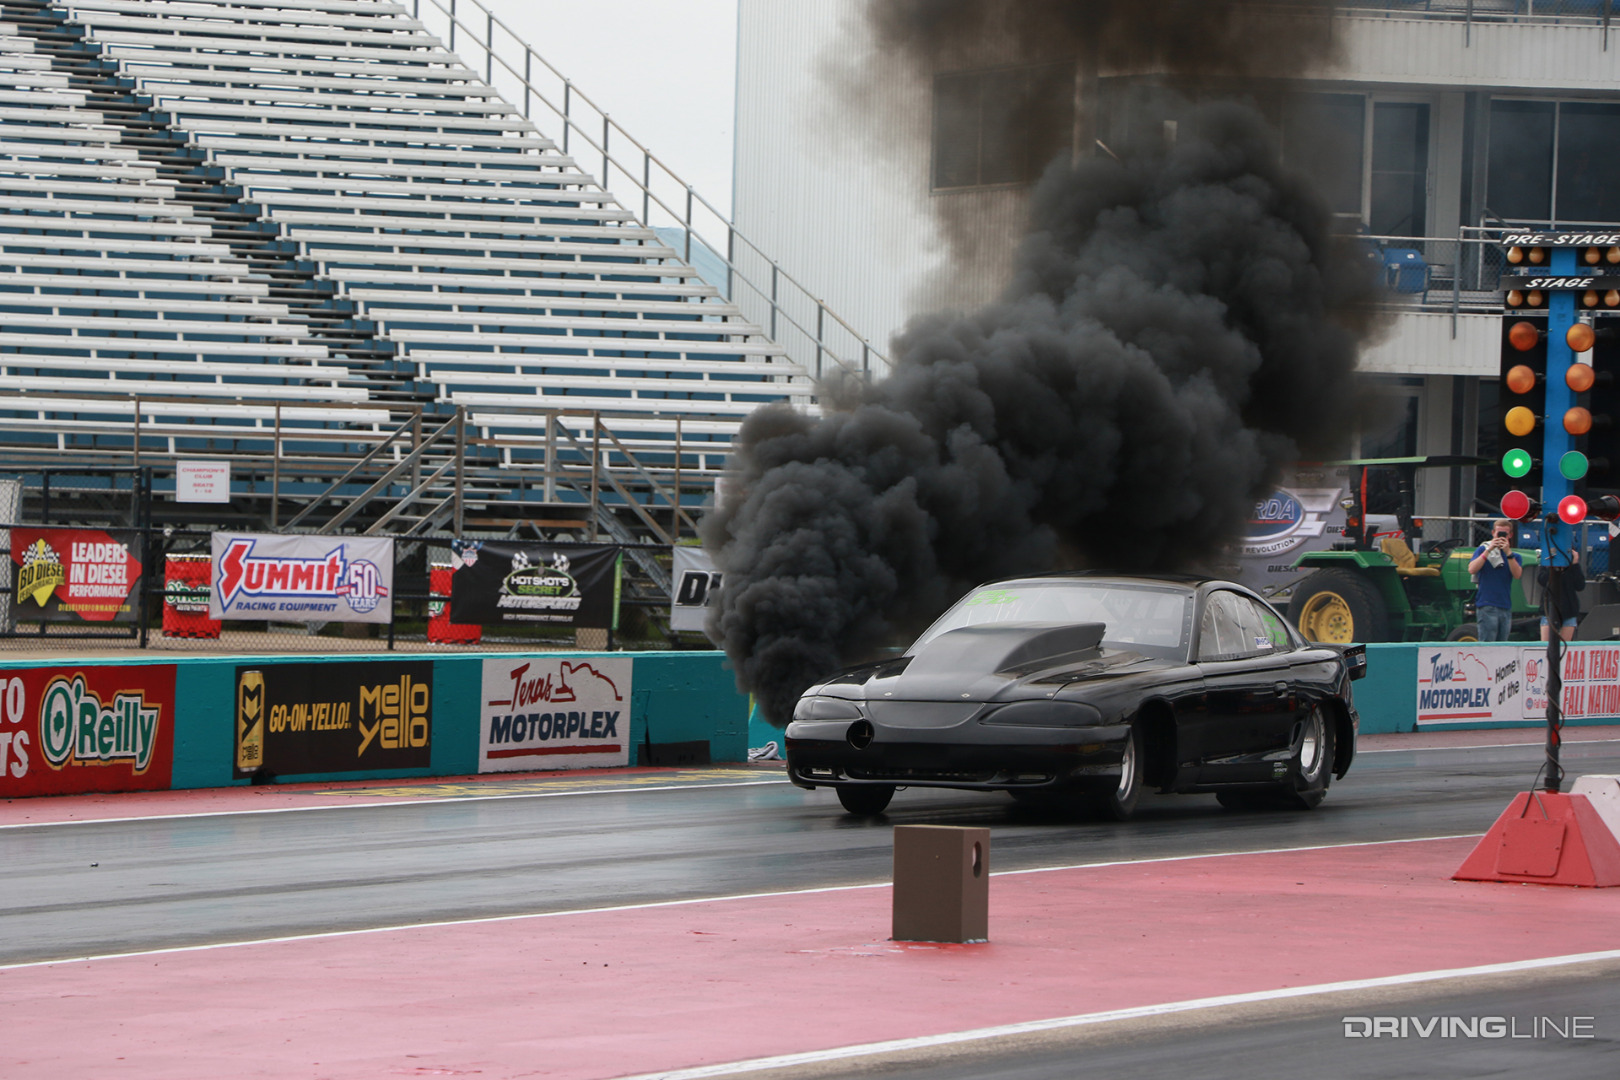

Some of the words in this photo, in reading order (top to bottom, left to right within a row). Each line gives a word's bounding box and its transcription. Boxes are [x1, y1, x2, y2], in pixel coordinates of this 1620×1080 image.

[1503, 234, 1620, 245] PRE-STAGE
[1525, 278, 1594, 288] STAGE
[72, 542, 128, 564] LEADERS
[1245, 537, 1296, 554] REVOLUTION
[20, 569, 34, 590] BD
[70, 563, 86, 584] IN
[87, 564, 128, 585] DIESEL
[349, 563, 377, 599] 50
[68, 584, 128, 598] PERFORMANCE.
[517, 585, 563, 595] SECRET
[235, 601, 276, 612] RACING
[279, 602, 338, 612] EQUIPMENT
[349, 598, 377, 608] YEARS
[497, 595, 582, 610] MOTORSPORTS
[1430, 653, 1454, 687] Texas
[1496, 660, 1516, 684] Home
[1564, 651, 1585, 680] AAA
[1589, 650, 1620, 679] TEXAS
[510, 663, 553, 712] Texas
[1420, 688, 1491, 709] MOTORPLEX
[1498, 685, 1506, 705] of
[1507, 681, 1520, 699] the
[1563, 686, 1585, 715] FALL
[41, 680, 159, 770] O'Reilly
[269, 702, 350, 732] GO-ON-YELLO!
[489, 711, 620, 744] MOTORPLEX
